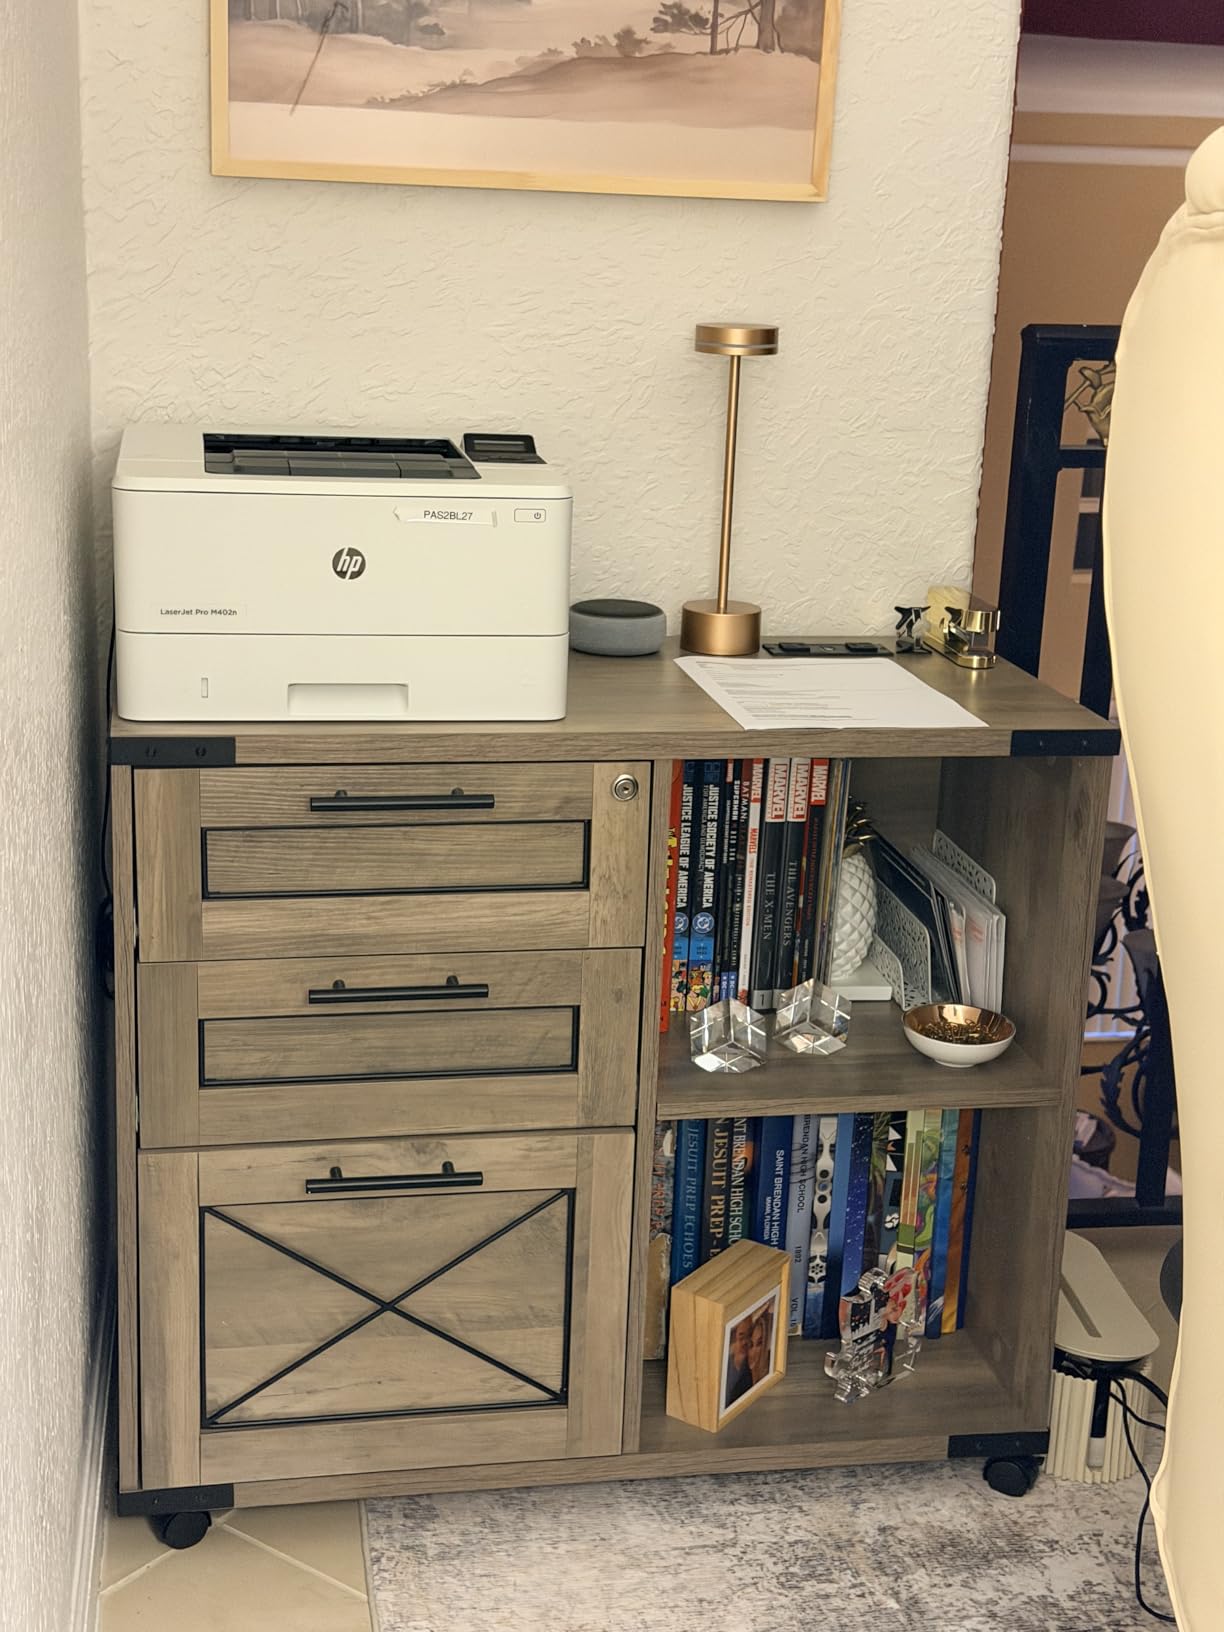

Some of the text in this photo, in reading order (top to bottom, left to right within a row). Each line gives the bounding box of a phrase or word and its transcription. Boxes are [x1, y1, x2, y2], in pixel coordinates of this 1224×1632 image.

[423, 510, 473, 521] PAS2BL27
[334, 547, 364, 580] hp
[160, 608, 238, 616] LaserJet Pro M402n
[731, 780, 741, 821] SUPERMAN
[751, 763, 763, 801] MARVEL
[772, 764, 787, 819] MARVEL
[793, 764, 809, 819] MARVEL
[811, 765, 828, 803] MARVEL
[681, 784, 694, 821] JUSTICE
[701, 798, 709, 825] AMERICA
[707, 784, 720, 821] JUSTICE
[680, 823, 691, 856] LEAGUE
[698, 837, 706, 872] DEMOCRACY
[705, 821, 718, 857] SOCIETY
[749, 828, 759, 854] MARVELS
[678, 857, 690, 870] OF
[704, 858, 716, 870] OF
[676, 870, 689, 908] AMERICA
[702, 871, 714, 908] AMERICA
[763, 872, 776, 940] THE X-MEN
[783, 861, 798, 946] THE AVENGERS
[711, 1128, 729, 1188] JESUIT
[731, 1135, 746, 1187] BRENDAN
[797, 1114, 811, 1213] BRENDAN HIGH SCHOOL
[682, 1128, 699, 1268] JESUIT PREP ECHOES
[729, 1188, 744, 1215] HIGH
[770, 1149, 785, 1245] SAINT BRENDAN HIGH
[709, 1195, 725, 1238] PREP
[763, 1215, 772, 1240] FLORIDA
